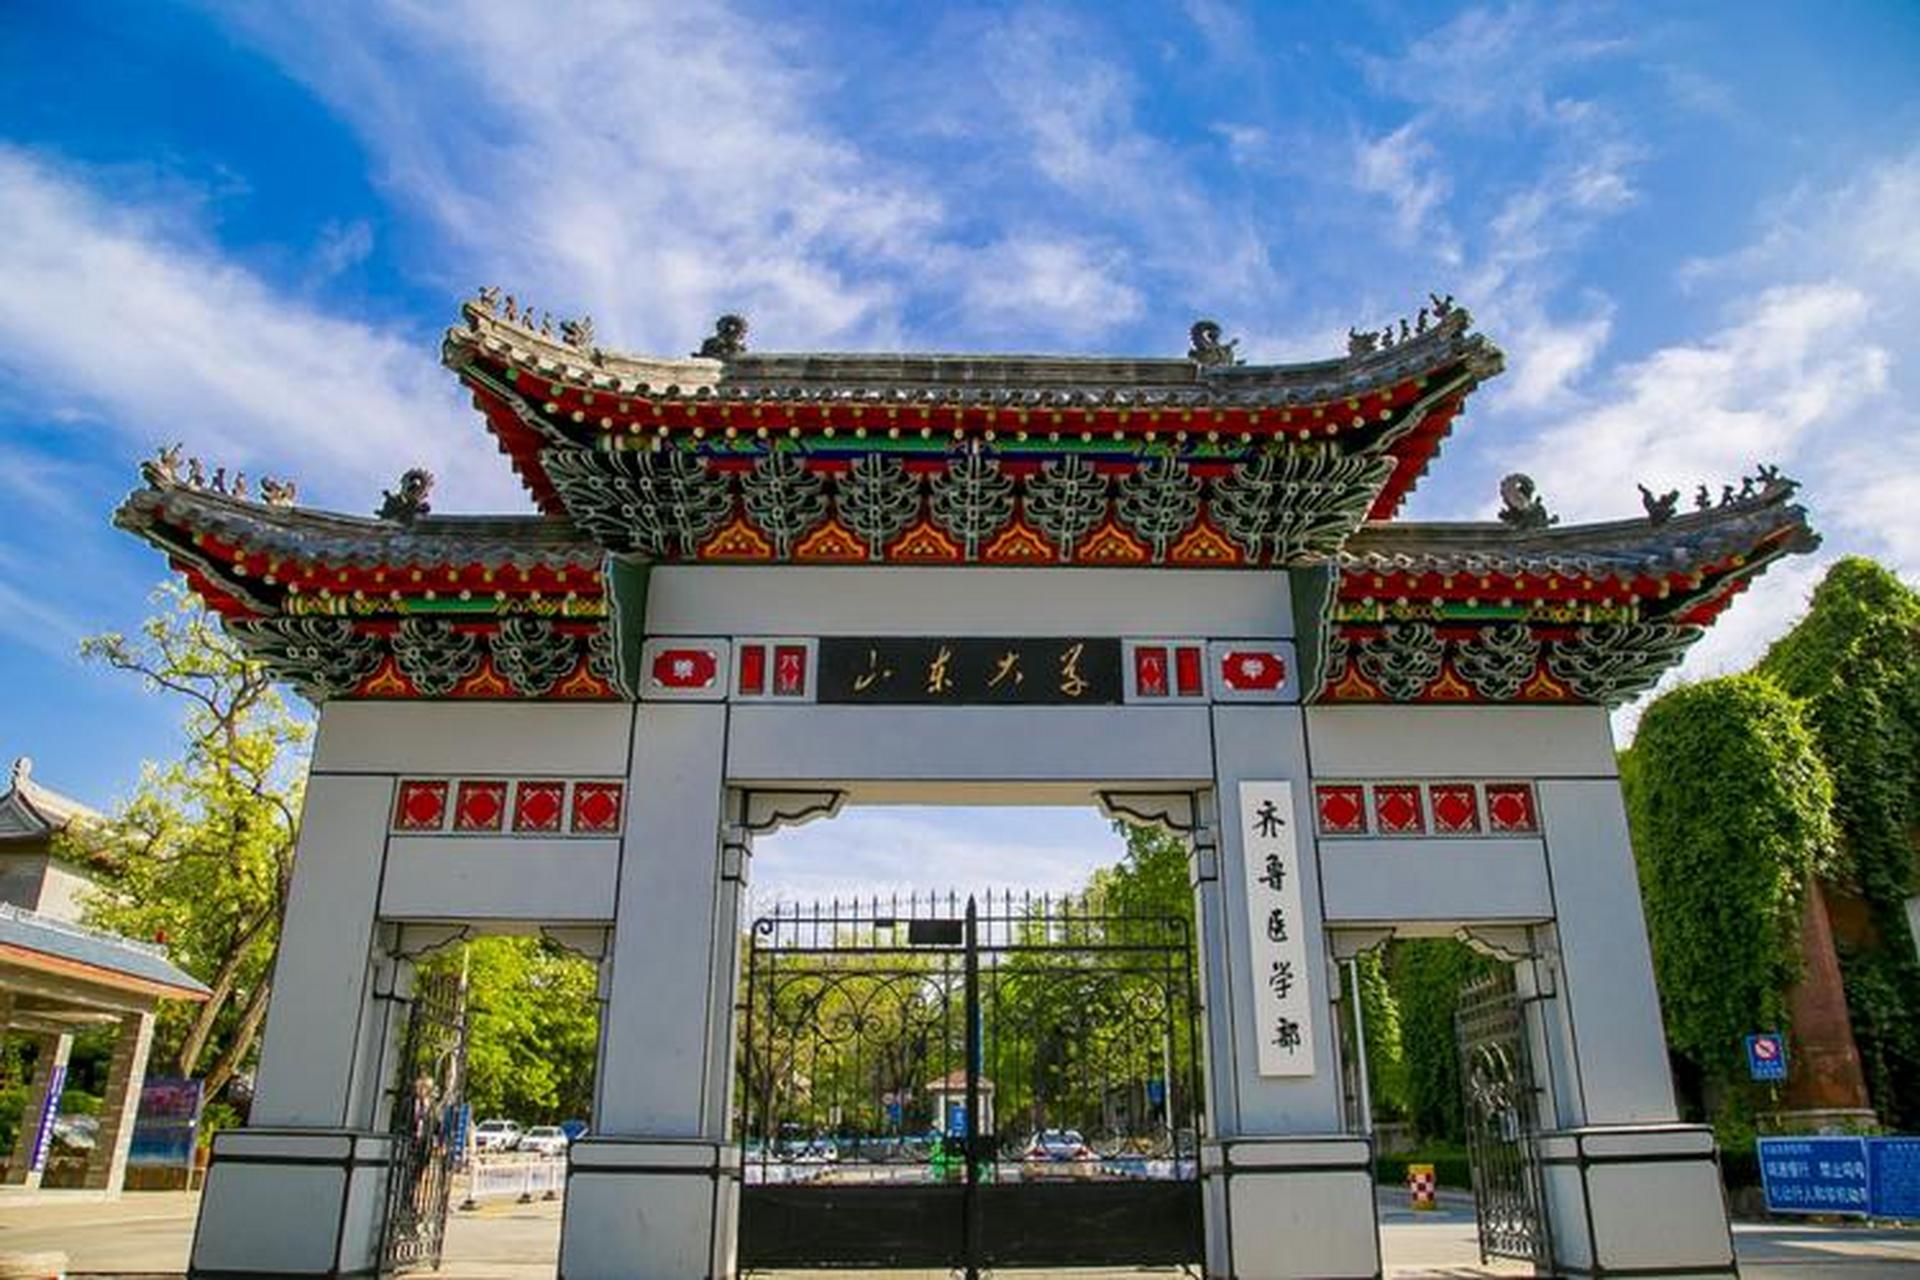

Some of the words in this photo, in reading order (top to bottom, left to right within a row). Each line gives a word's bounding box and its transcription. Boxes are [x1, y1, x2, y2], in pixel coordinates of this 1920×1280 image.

[854, 643, 1089, 695] 山东大学
[1253, 800, 1301, 1055] 齐鲁医学部
